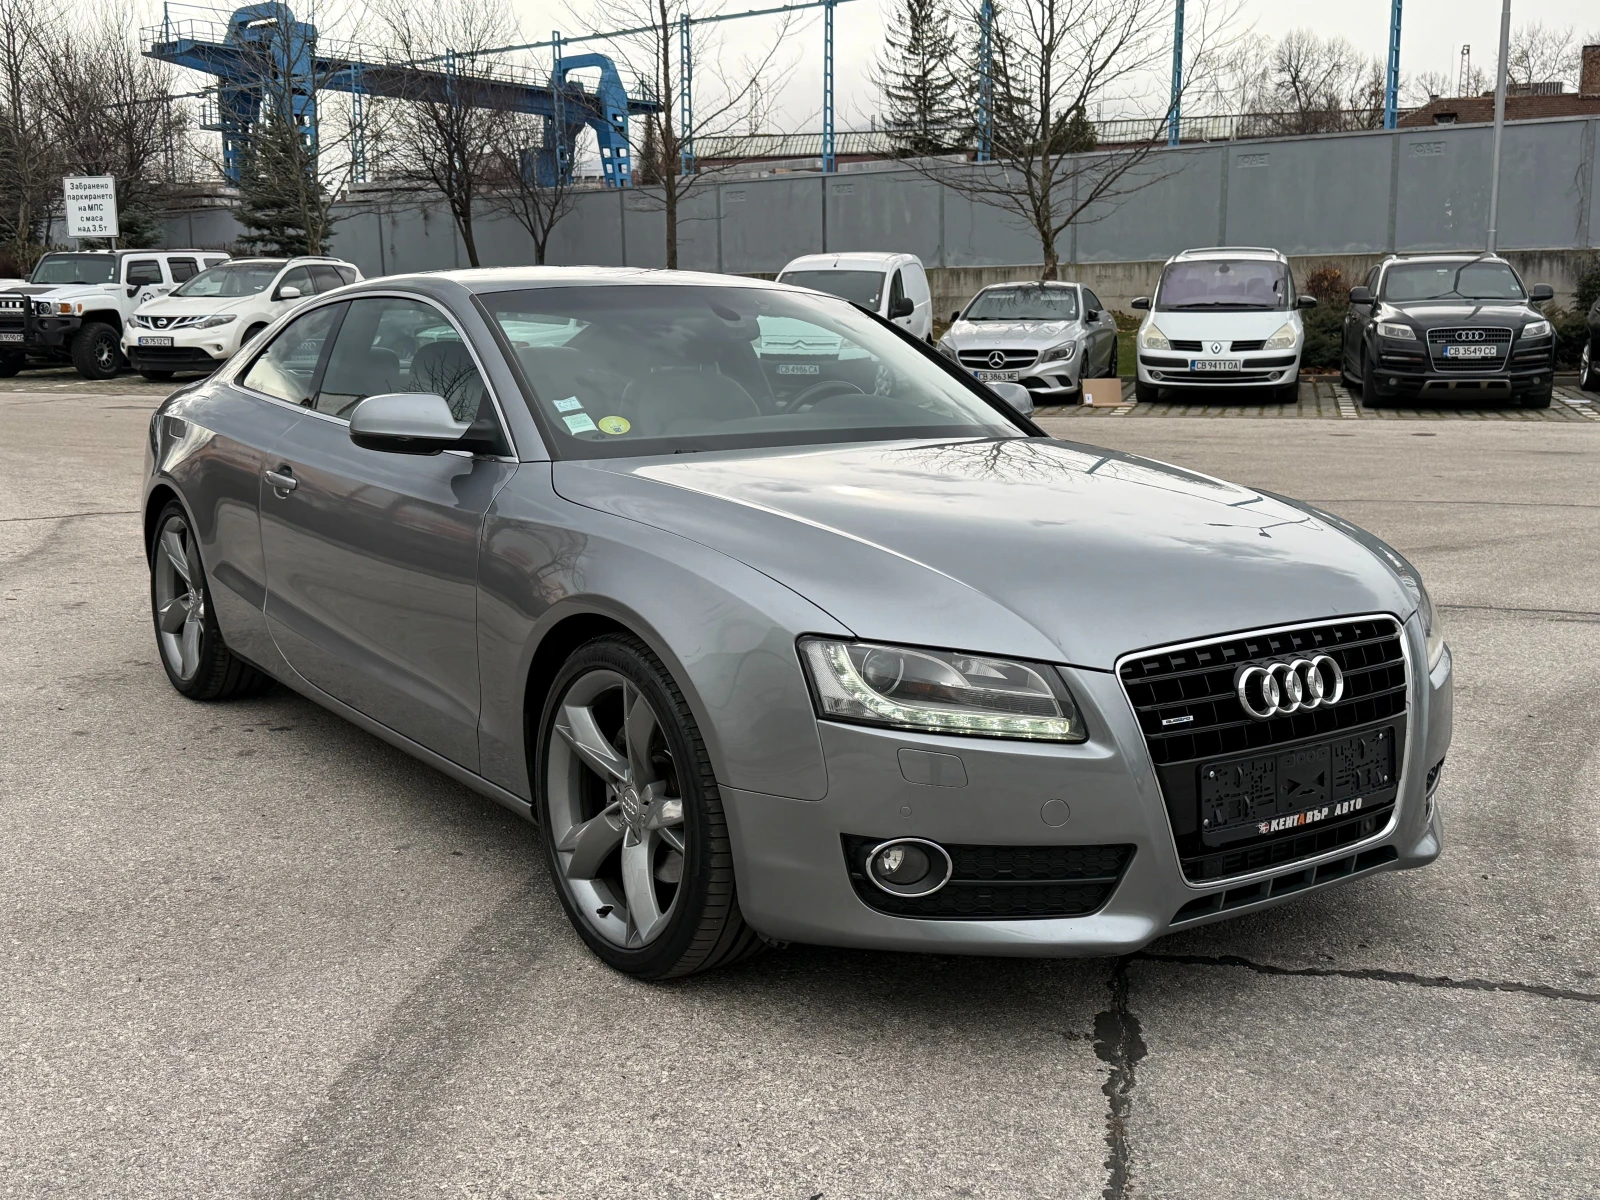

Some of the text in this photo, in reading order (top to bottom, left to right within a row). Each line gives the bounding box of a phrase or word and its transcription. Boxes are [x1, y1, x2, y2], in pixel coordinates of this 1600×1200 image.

[70, 182, 109, 191] Забранено
[67, 193, 113, 202] паркирането
[87, 203, 104, 212] МПС
[1461, 347, 1482, 356] 3549
[1207, 361, 1227, 370] 9411
[1270, 797, 1363, 832] КЕНТАВЪР АВТО
